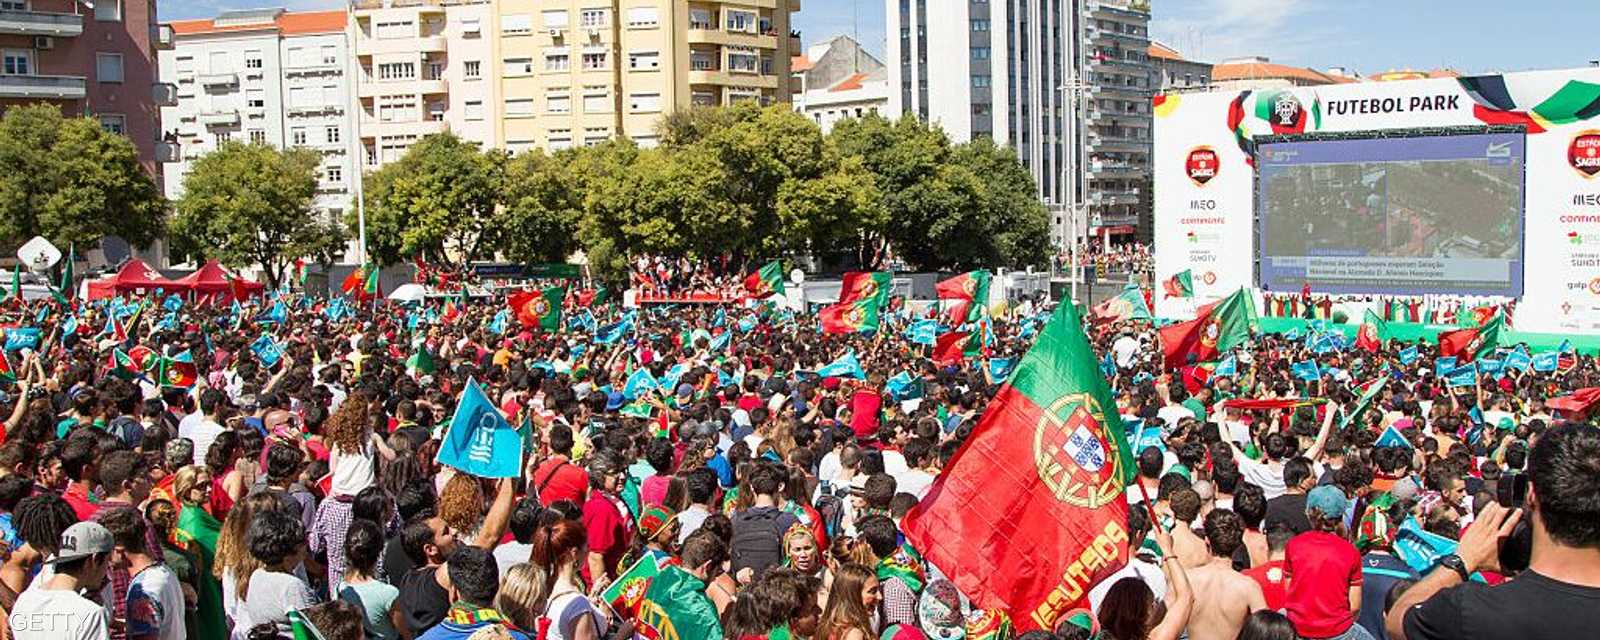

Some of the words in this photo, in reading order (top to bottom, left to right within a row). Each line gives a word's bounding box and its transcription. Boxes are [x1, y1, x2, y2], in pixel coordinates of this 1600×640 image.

[1327, 97, 1404, 116] FUTEBOL
[1409, 94, 1459, 112] PARK
[1190, 199, 1216, 210] MEO
